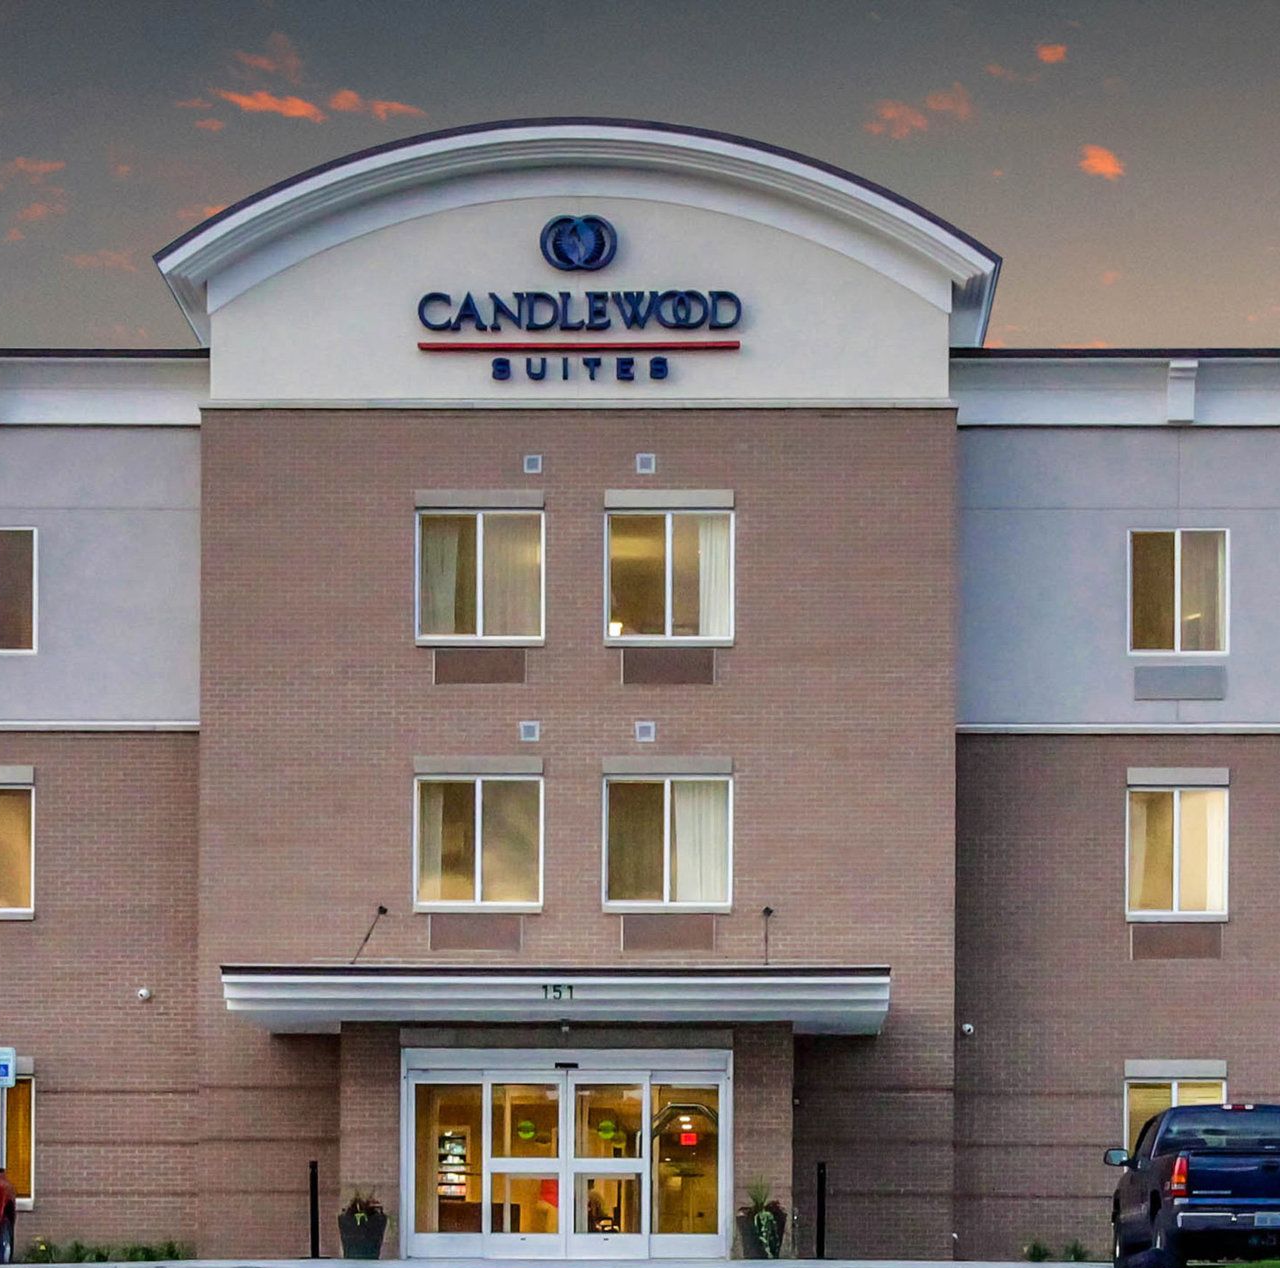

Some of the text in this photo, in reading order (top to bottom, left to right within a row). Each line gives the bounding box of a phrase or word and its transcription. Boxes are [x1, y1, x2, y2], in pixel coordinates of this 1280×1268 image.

[417, 290, 742, 331] CANDLEWOOD
[491, 356, 669, 380] SUITES
[542, 984, 574, 1000] 151
